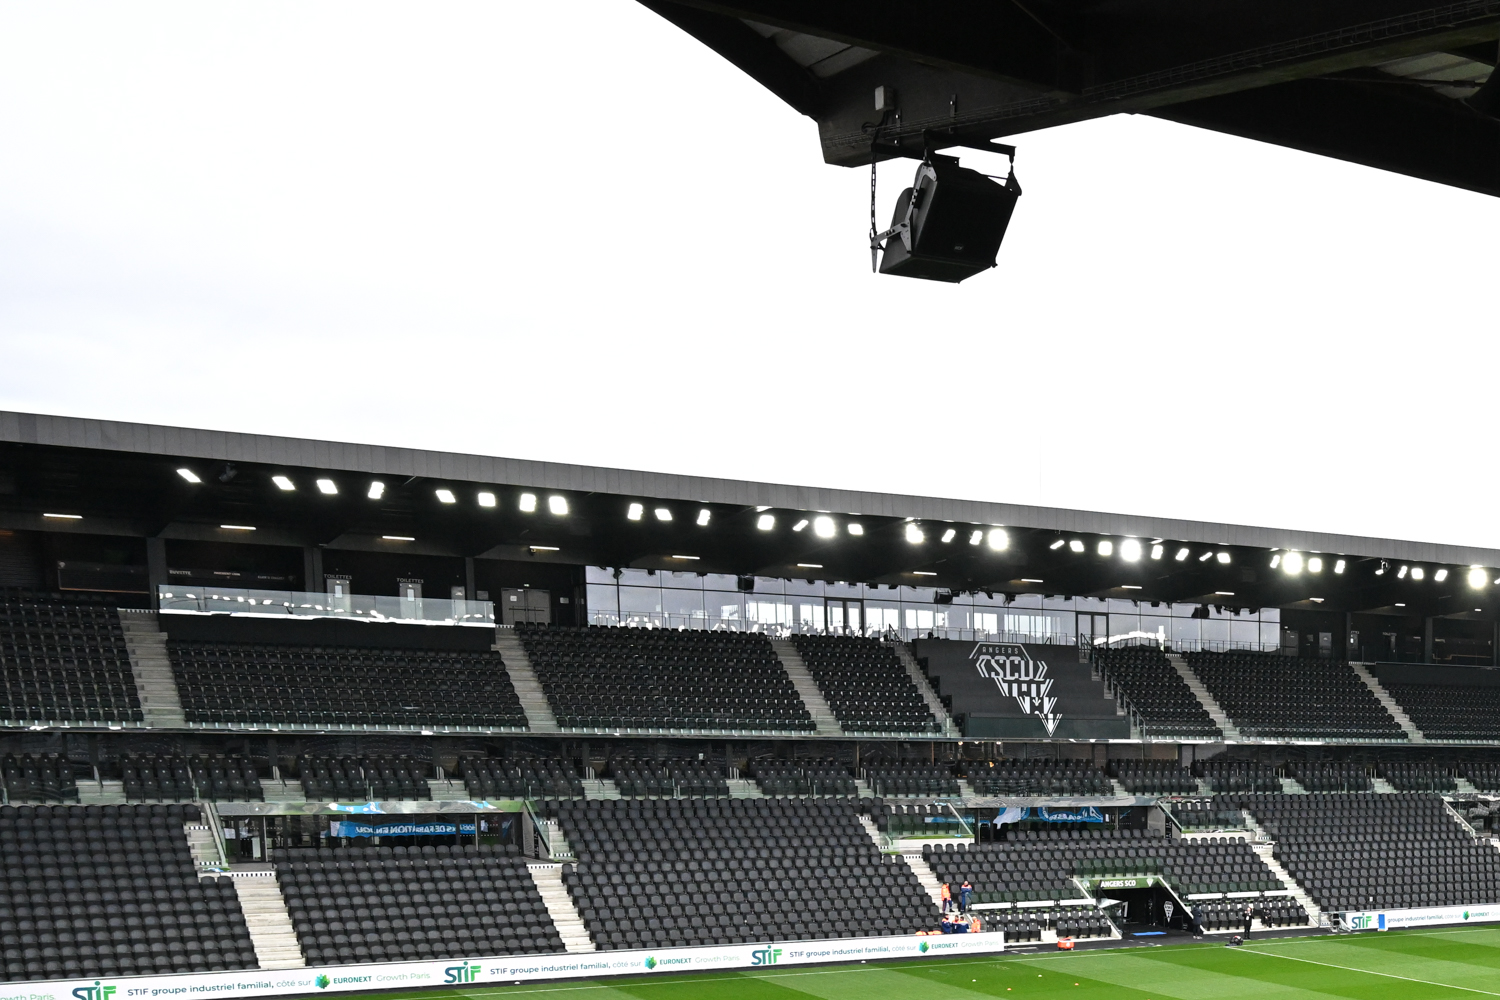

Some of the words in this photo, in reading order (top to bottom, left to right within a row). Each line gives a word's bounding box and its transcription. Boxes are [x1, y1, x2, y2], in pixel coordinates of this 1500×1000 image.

[982, 646, 1018, 654] ANGERS
[1100, 880, 1123, 888] ANGERS
[806, 950, 830, 959] groupe
[832, 947, 863, 955] industriel
[660, 957, 691, 965] EURONEXT
[509, 967, 539, 975] groupe
[541, 963, 579, 972] industriel
[580, 962, 611, 970] familial,
[333, 976, 372, 984] EURONEXT
[376, 974, 408, 982] Growth
[127, 988, 149, 996] STIF
[152, 986, 187, 996] groupe
[190, 984, 234, 993] industriel
[237, 980, 274, 990] familial,
[276, 979, 297, 988] côté
